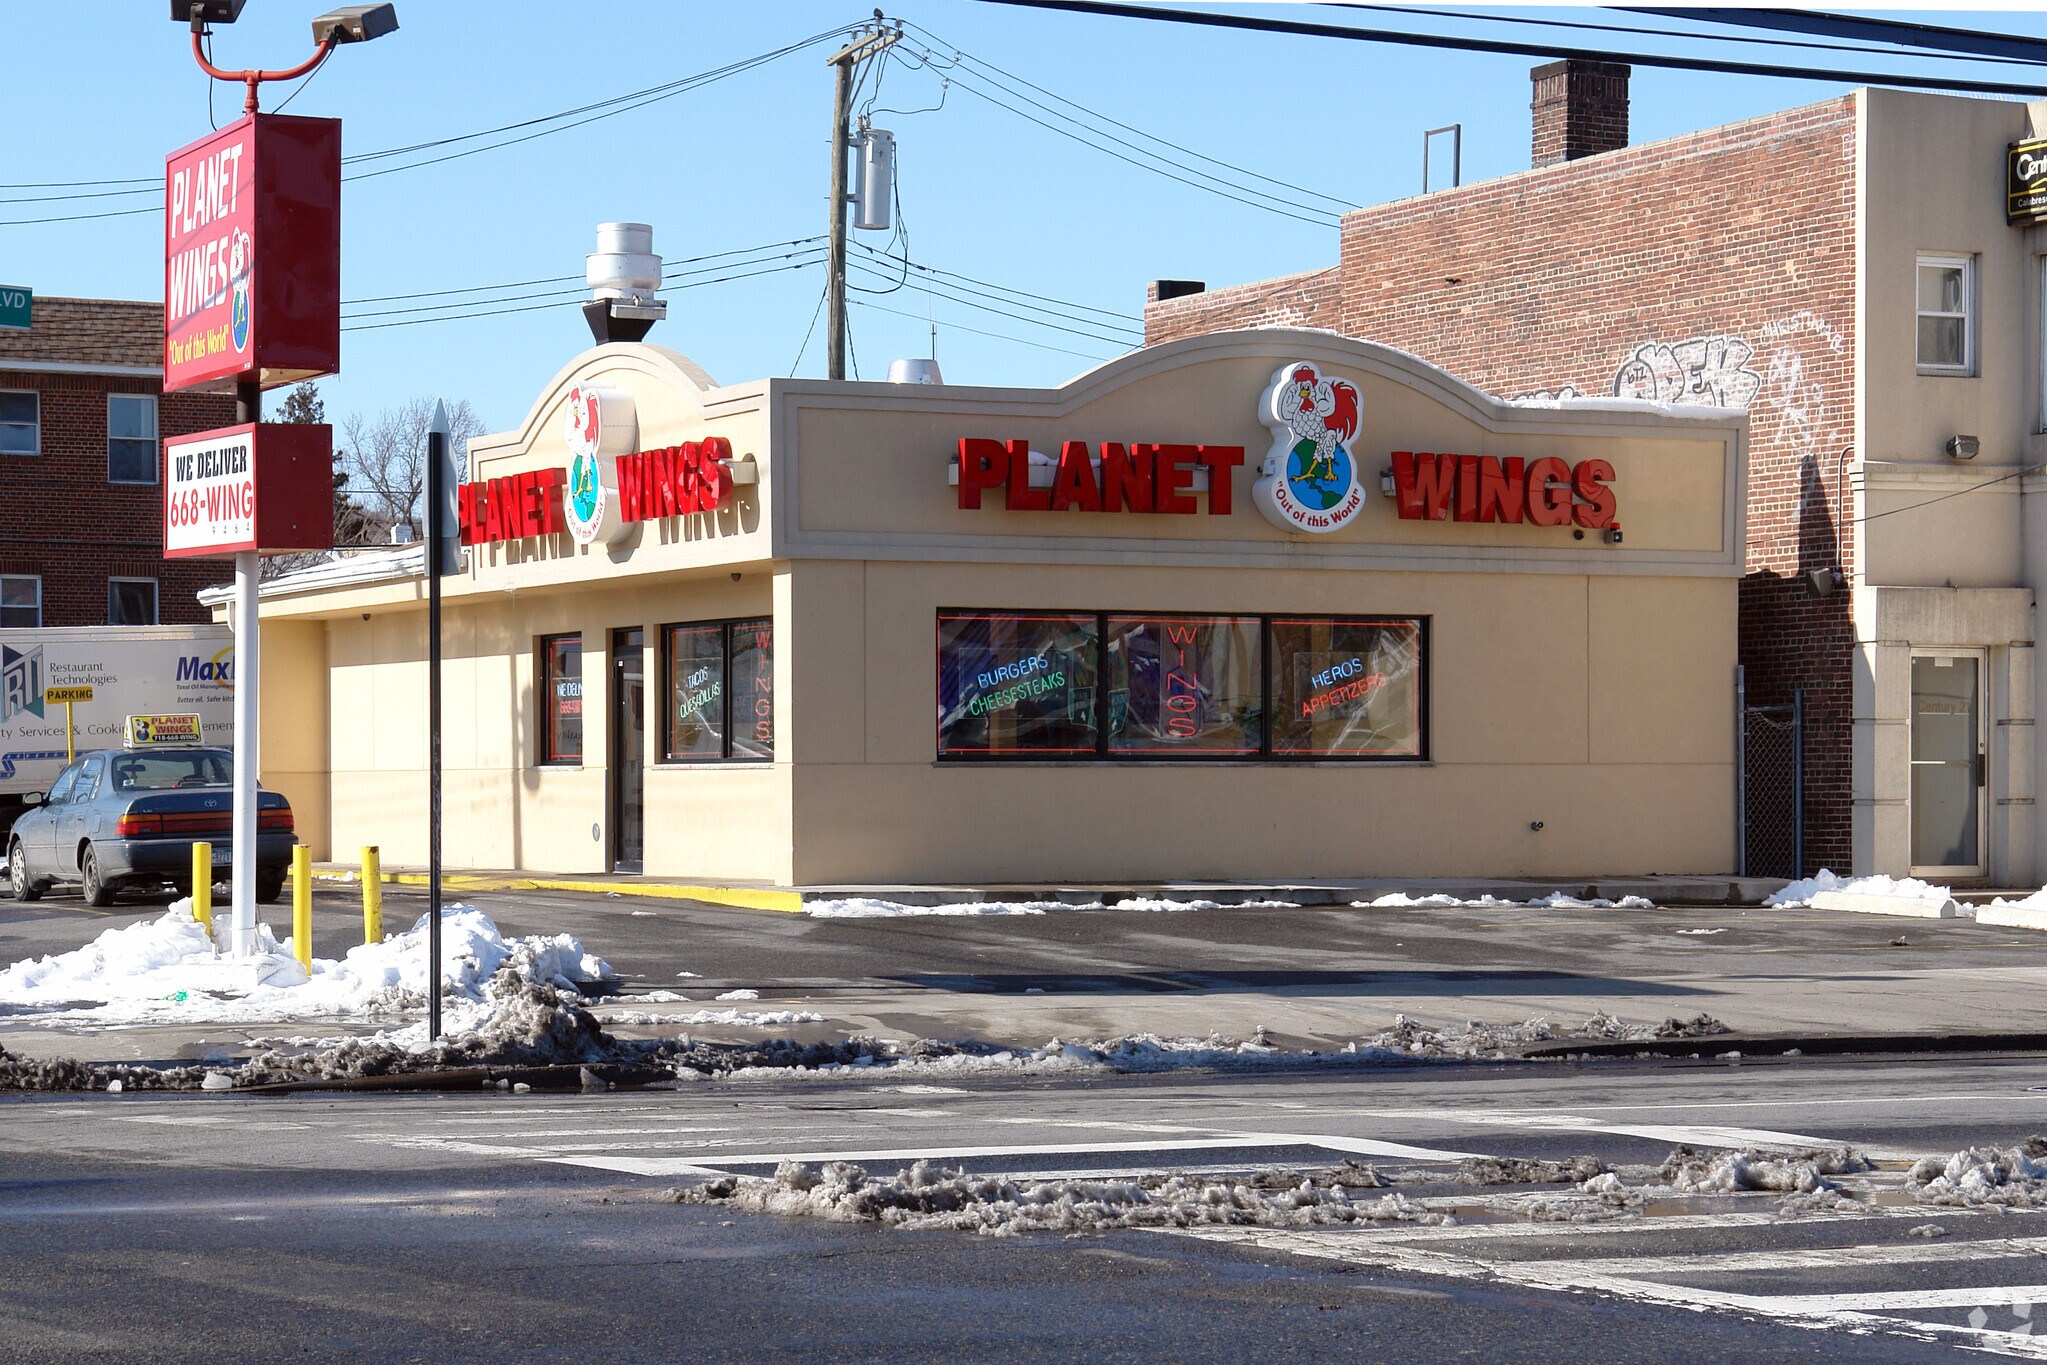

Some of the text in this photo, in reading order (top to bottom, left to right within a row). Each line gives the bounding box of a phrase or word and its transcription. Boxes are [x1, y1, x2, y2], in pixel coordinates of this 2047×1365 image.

[171, 142, 243, 239] PLANET
[170, 236, 229, 321] WINGS
[0, 291, 26, 309] VD
[184, 334, 193, 362] of
[194, 332, 206, 360] this
[176, 445, 247, 482] WE DELIVER
[615, 436, 734, 524] WINGS
[958, 438, 1617, 529] PLANET WINGS
[170, 480, 253, 527] 668-WING
[1292, 511, 1306, 523] of
[1307, 515, 1330, 527] this
[3, 644, 43, 720] RTI
[50, 662, 104, 673] Restaurant
[51, 673, 118, 687] Technologies
[176, 656, 235, 681] Max
[688, 666, 709, 689] TACOS
[977, 653, 1049, 690] BURGERS
[1167, 626, 1198, 737] WINGS
[1312, 657, 1363, 690] HEROS
[47, 689, 93, 701] PARKING
[680, 682, 721, 718] QUESADILLAS
[755, 631, 771, 740] WINGS
[970, 671, 1066, 716] CHEESESTEAKS
[1301, 671, 1387, 718] APPETIZERS
[151, 716, 195, 725] PLANET
[1918, 699, 1956, 715] Century
[19, 726, 66, 738] Services
[73, 724, 81, 735] &
[155, 725, 193, 734] WINGS
